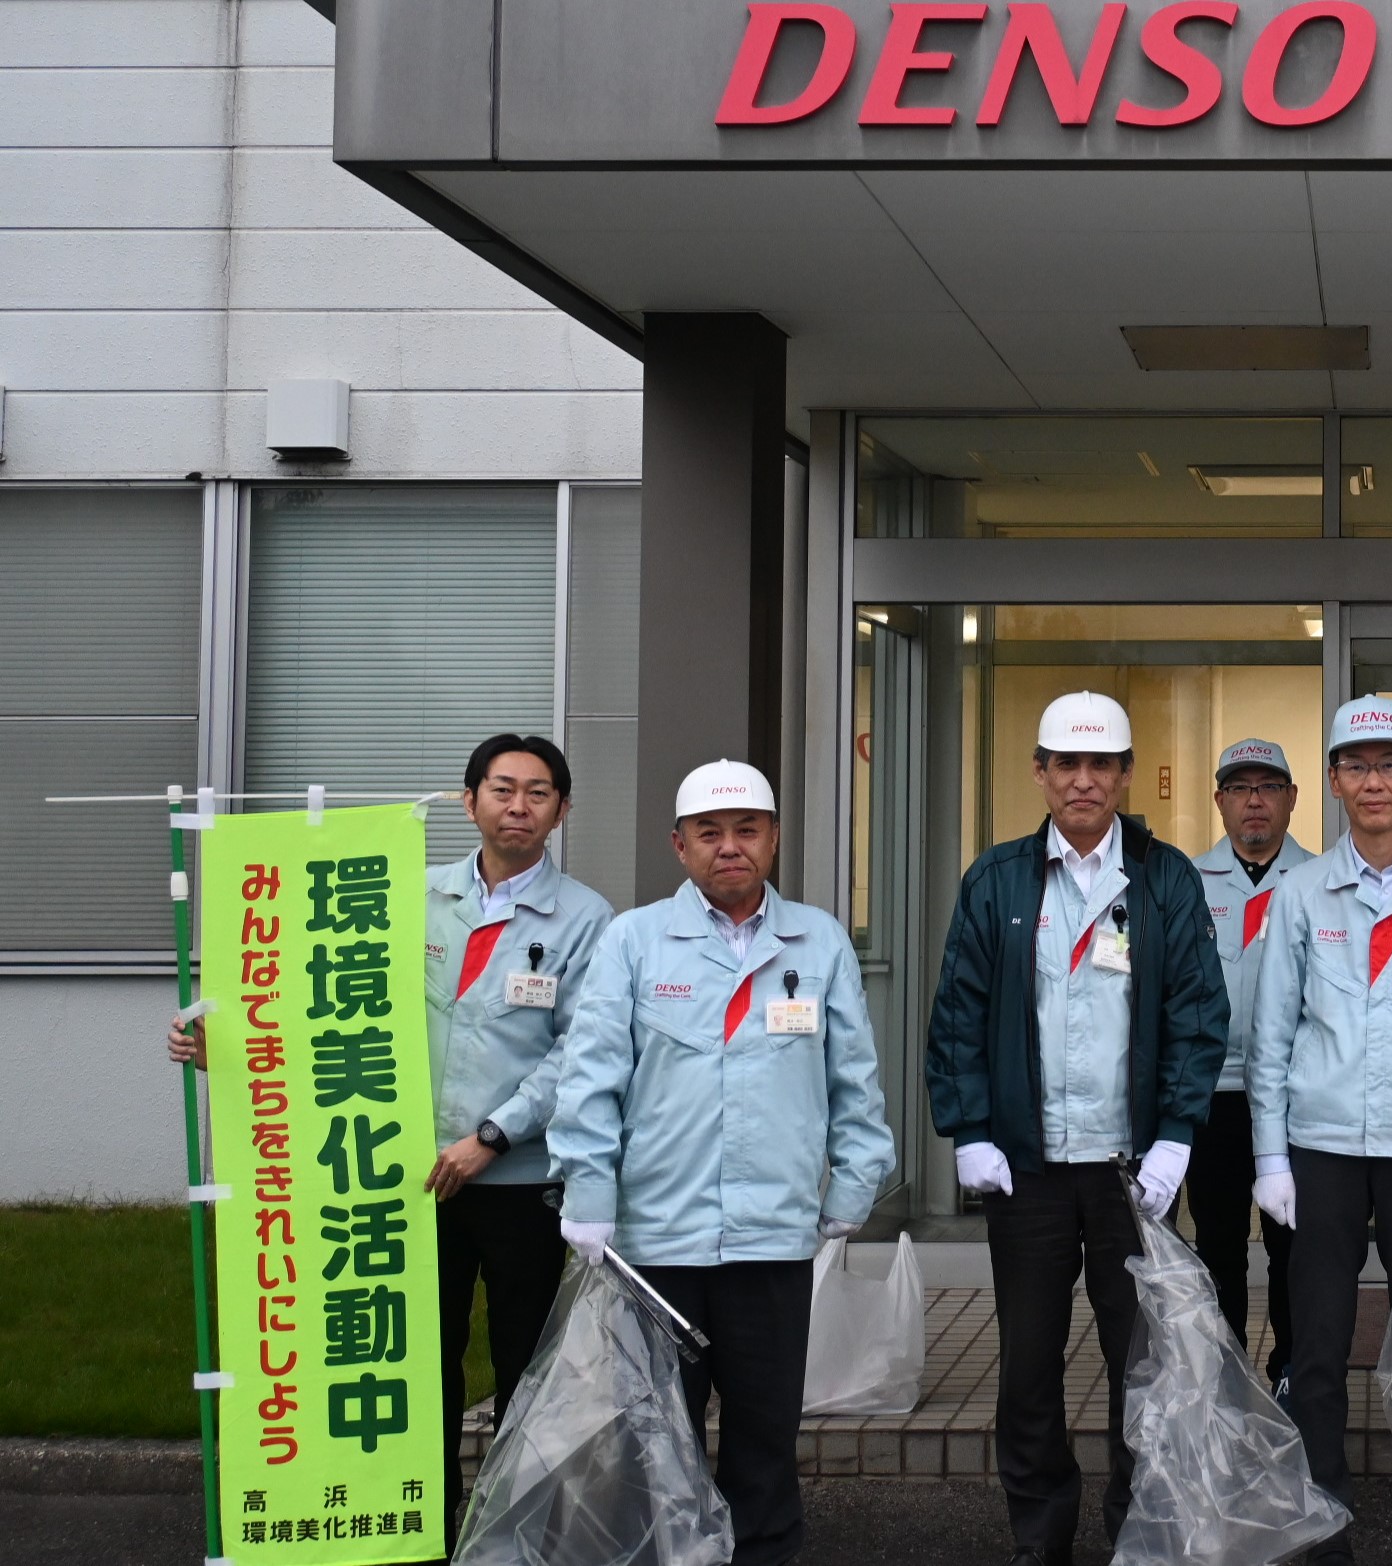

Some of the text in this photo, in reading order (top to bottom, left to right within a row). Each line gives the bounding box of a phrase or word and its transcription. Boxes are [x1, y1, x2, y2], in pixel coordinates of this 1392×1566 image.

[715, 1, 1377, 127] DENSO
[1071, 725, 1105, 733] DENSO
[1231, 746, 1272, 758] DENSO
[711, 786, 747, 795] DENSO
[1317, 929, 1347, 938] DENSO
[425, 943, 444, 954] NSO
[655, 984, 692, 992] DENSO
[306, 855, 409, 1454] 環境美化活動中
[242, 864, 299, 1465] みんなでまちをきれいにしよう
[243, 1479, 424, 1513] 高浜市
[243, 1511, 424, 1544] 環境美化推進員
